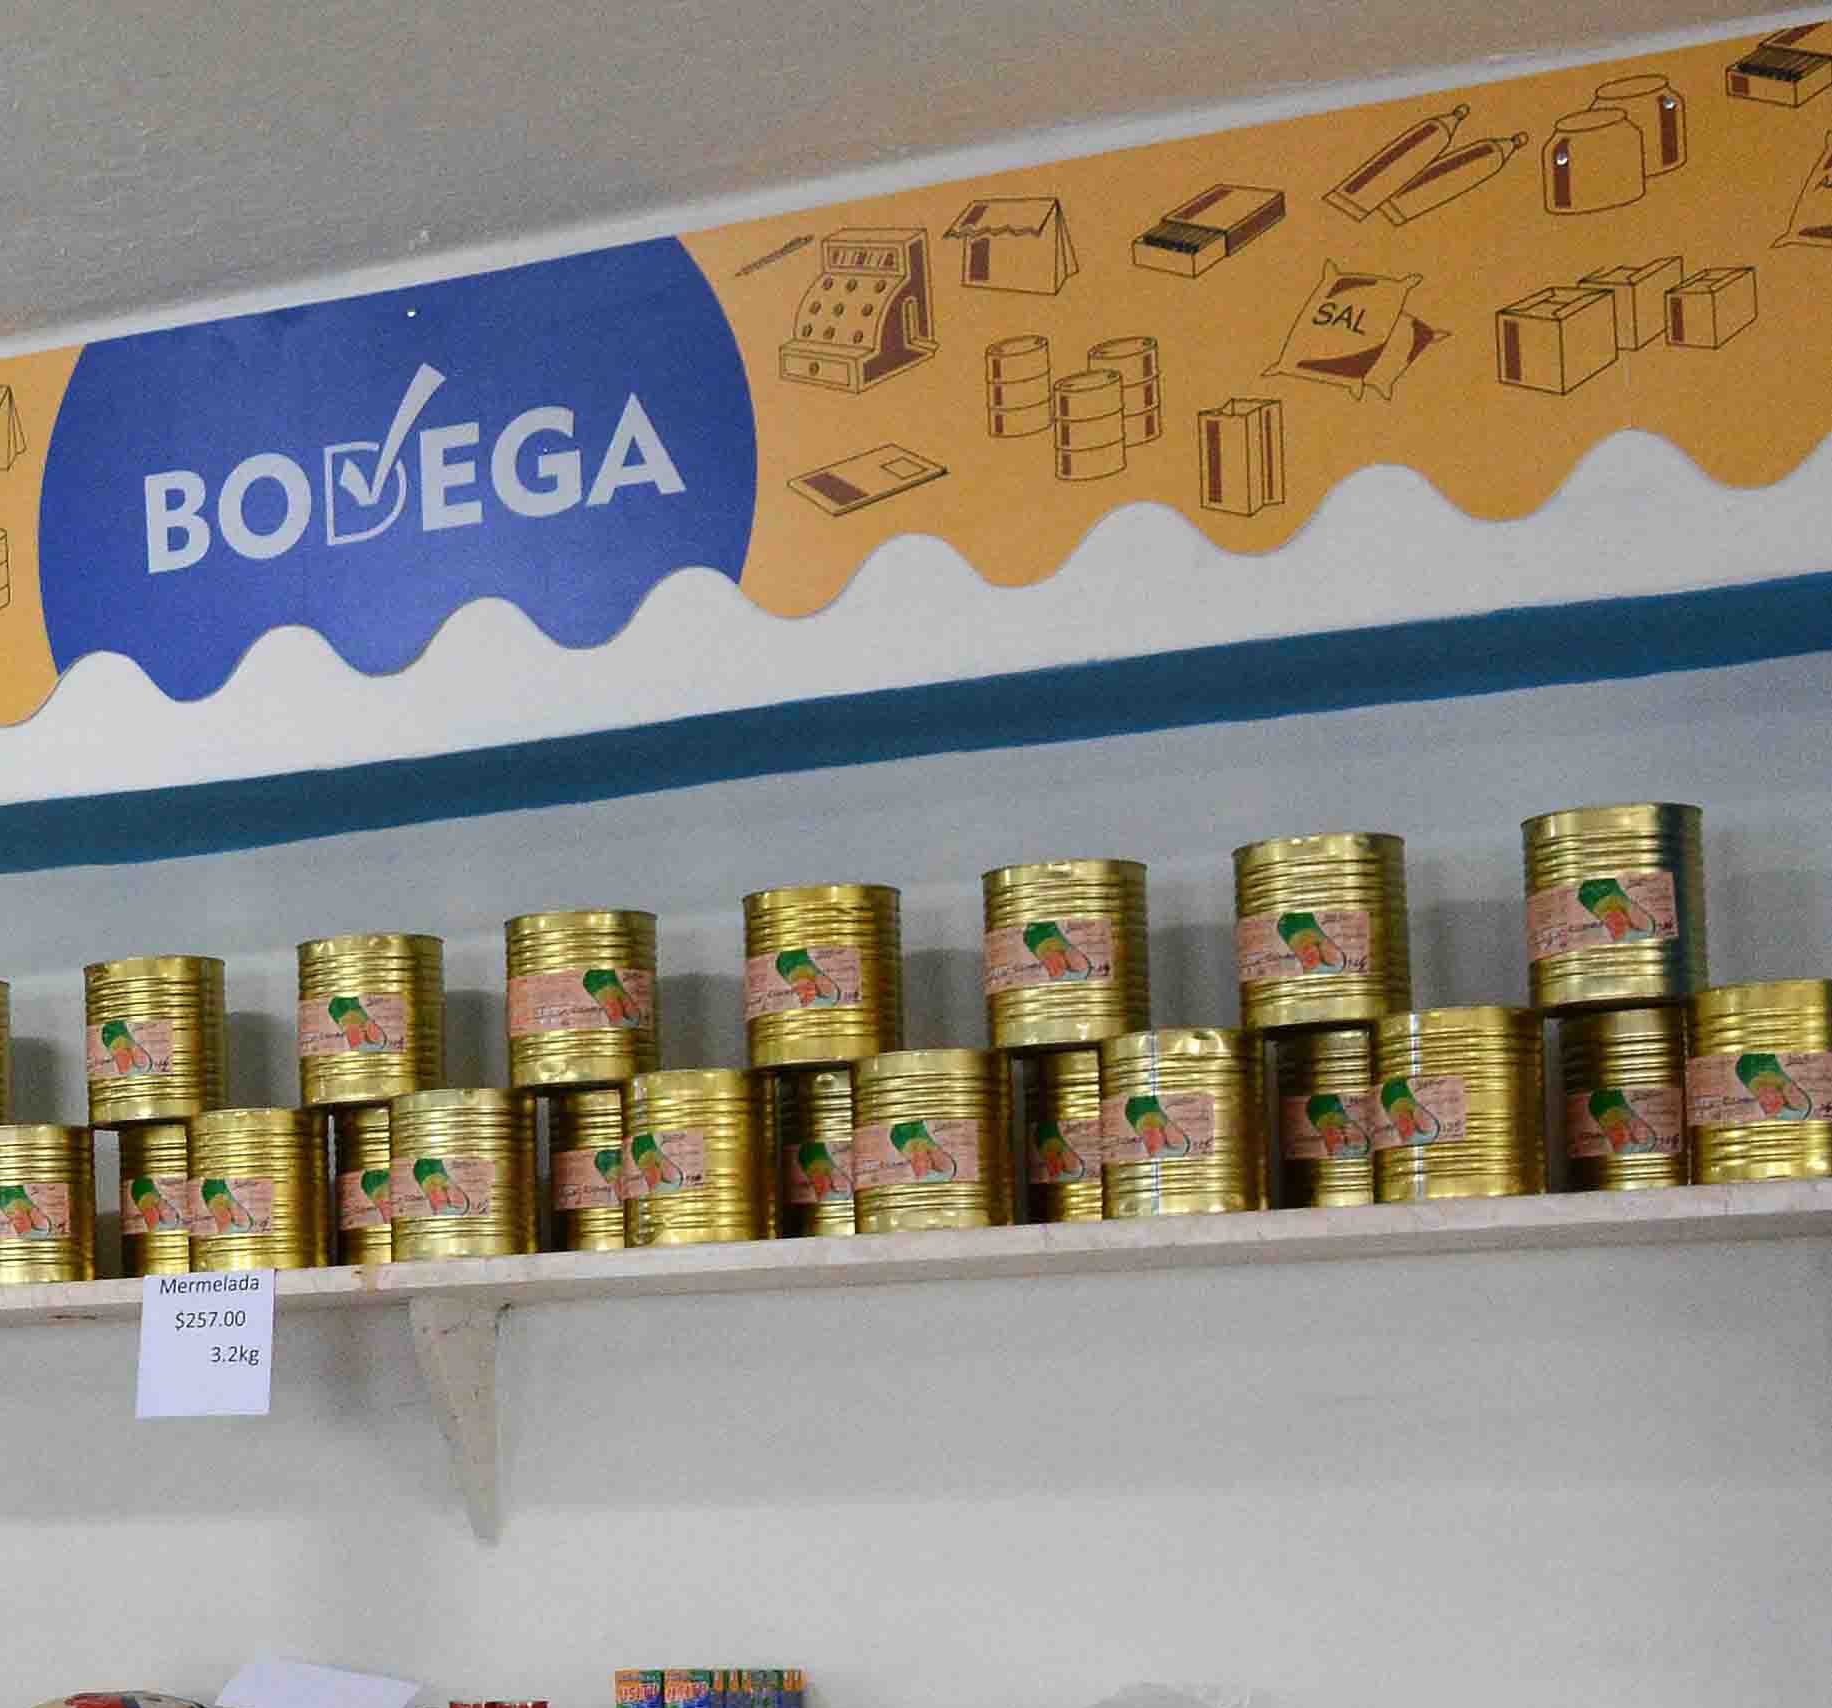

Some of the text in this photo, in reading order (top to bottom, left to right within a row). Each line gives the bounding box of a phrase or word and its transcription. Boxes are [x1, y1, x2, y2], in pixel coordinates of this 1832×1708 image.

[1312, 302, 1366, 336] SAL
[144, 363, 686, 574] BODEGA
[159, 1274, 260, 1295] Mermelada
[175, 1310, 246, 1331] $257.00
[210, 1344, 260, 1366] 3.2kg
